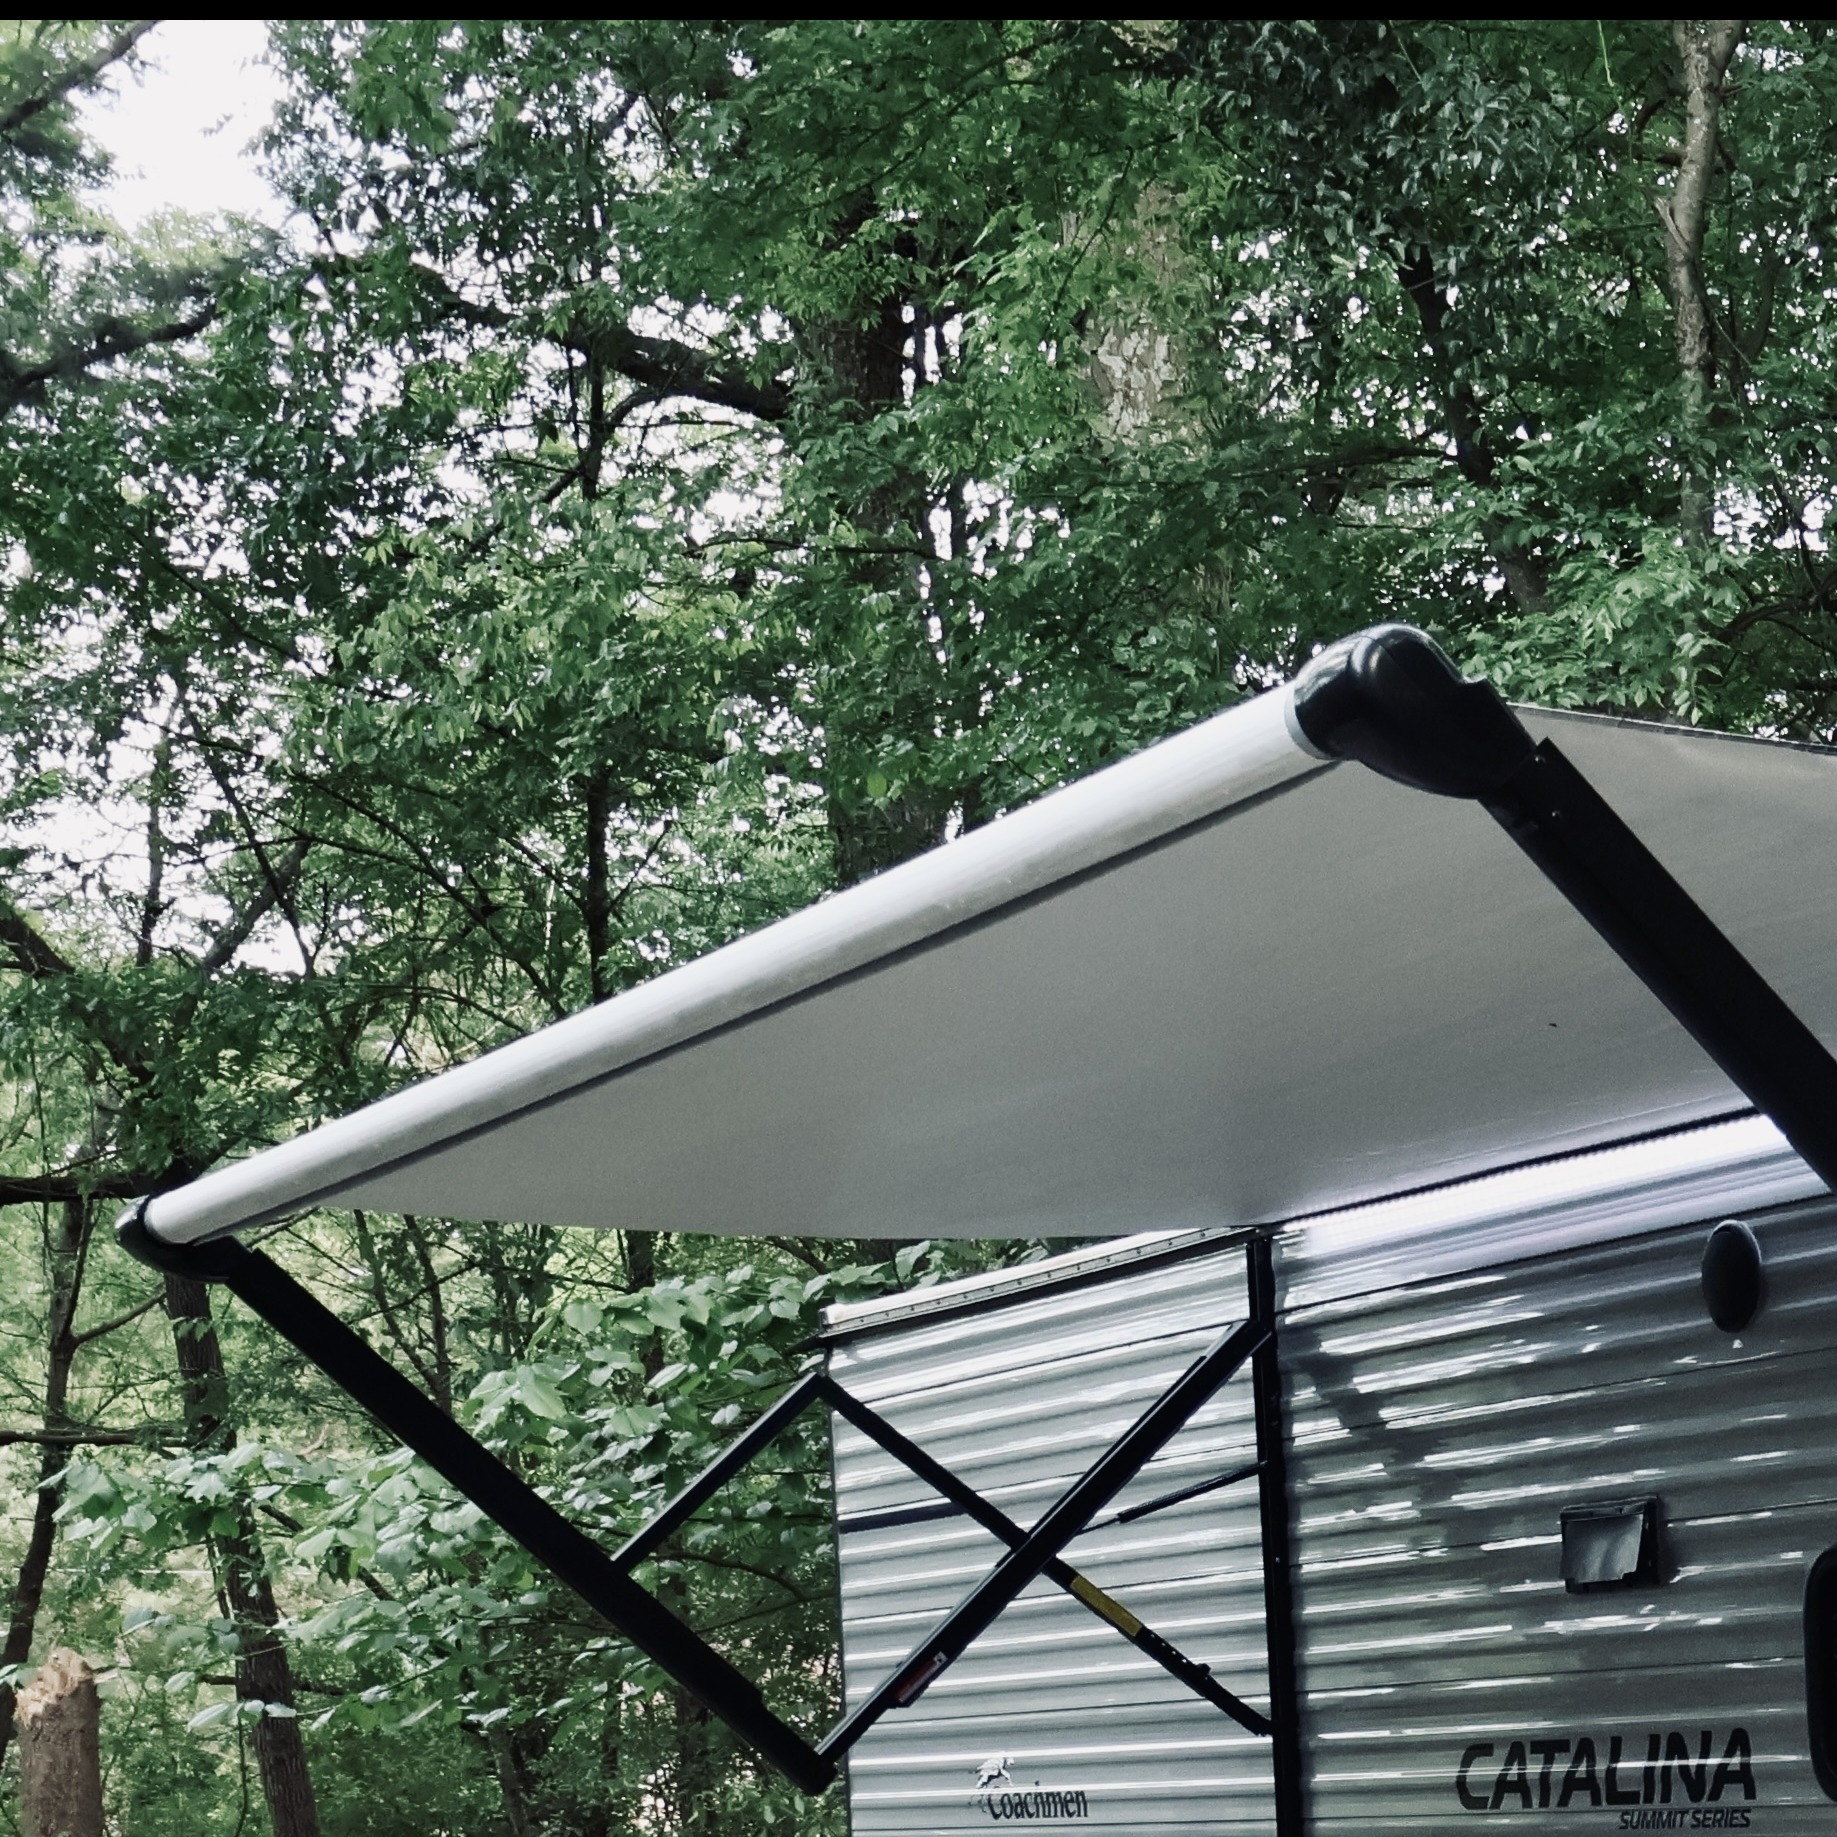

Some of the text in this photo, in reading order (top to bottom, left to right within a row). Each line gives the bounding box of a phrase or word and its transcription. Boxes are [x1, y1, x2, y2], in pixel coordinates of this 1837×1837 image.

[1456, 1727, 1757, 1811] CATALINA
[987, 1780, 1088, 1820] Coachmen
[1619, 1808, 1752, 1829] SUMMIT SERIES
